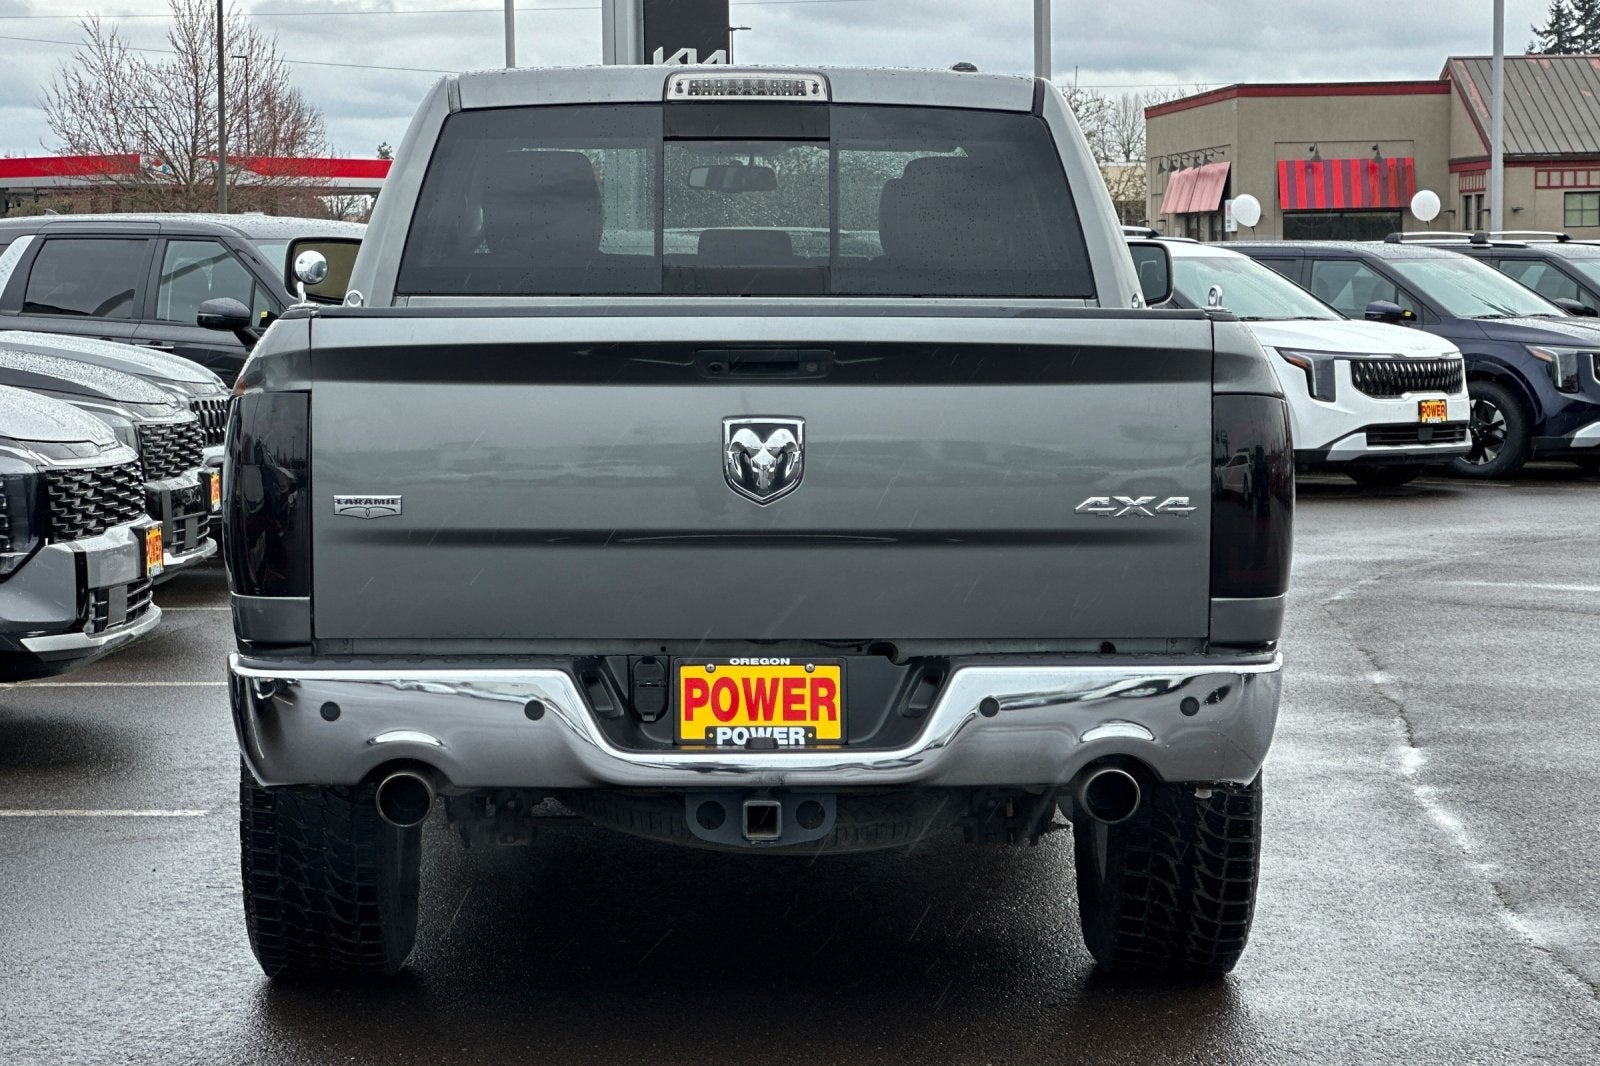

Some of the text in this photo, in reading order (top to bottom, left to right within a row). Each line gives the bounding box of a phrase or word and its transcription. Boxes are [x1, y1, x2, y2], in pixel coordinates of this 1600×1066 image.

[653, 46, 727, 65] KIA
[1421, 404, 1446, 417] POWER
[729, 657, 791, 666] OREGON
[684, 676, 837, 722] POWER
[716, 727, 806, 745] POWER
